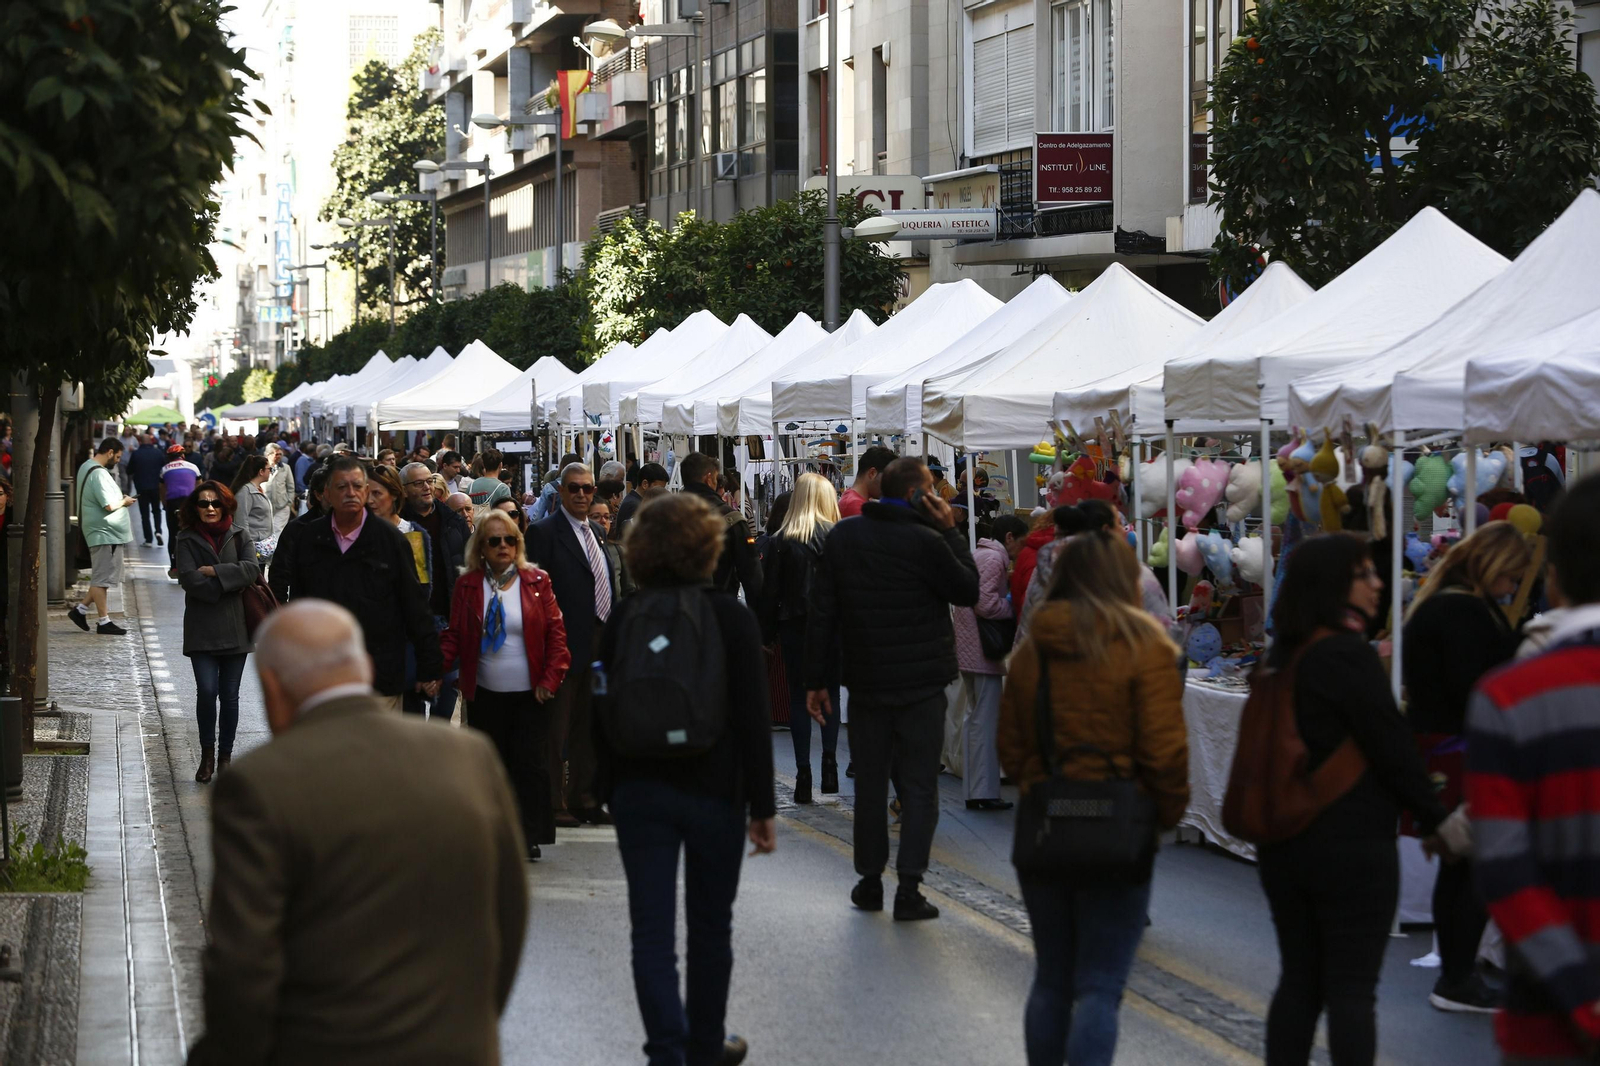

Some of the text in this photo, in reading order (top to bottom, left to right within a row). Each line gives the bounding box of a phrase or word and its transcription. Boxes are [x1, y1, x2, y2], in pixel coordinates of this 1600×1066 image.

[1039, 163, 1106, 171] INSTITUT LINE
[951, 220, 990, 228] ESTETICA
[277, 184, 290, 297] GARAGE
[260, 307, 290, 321] REX
